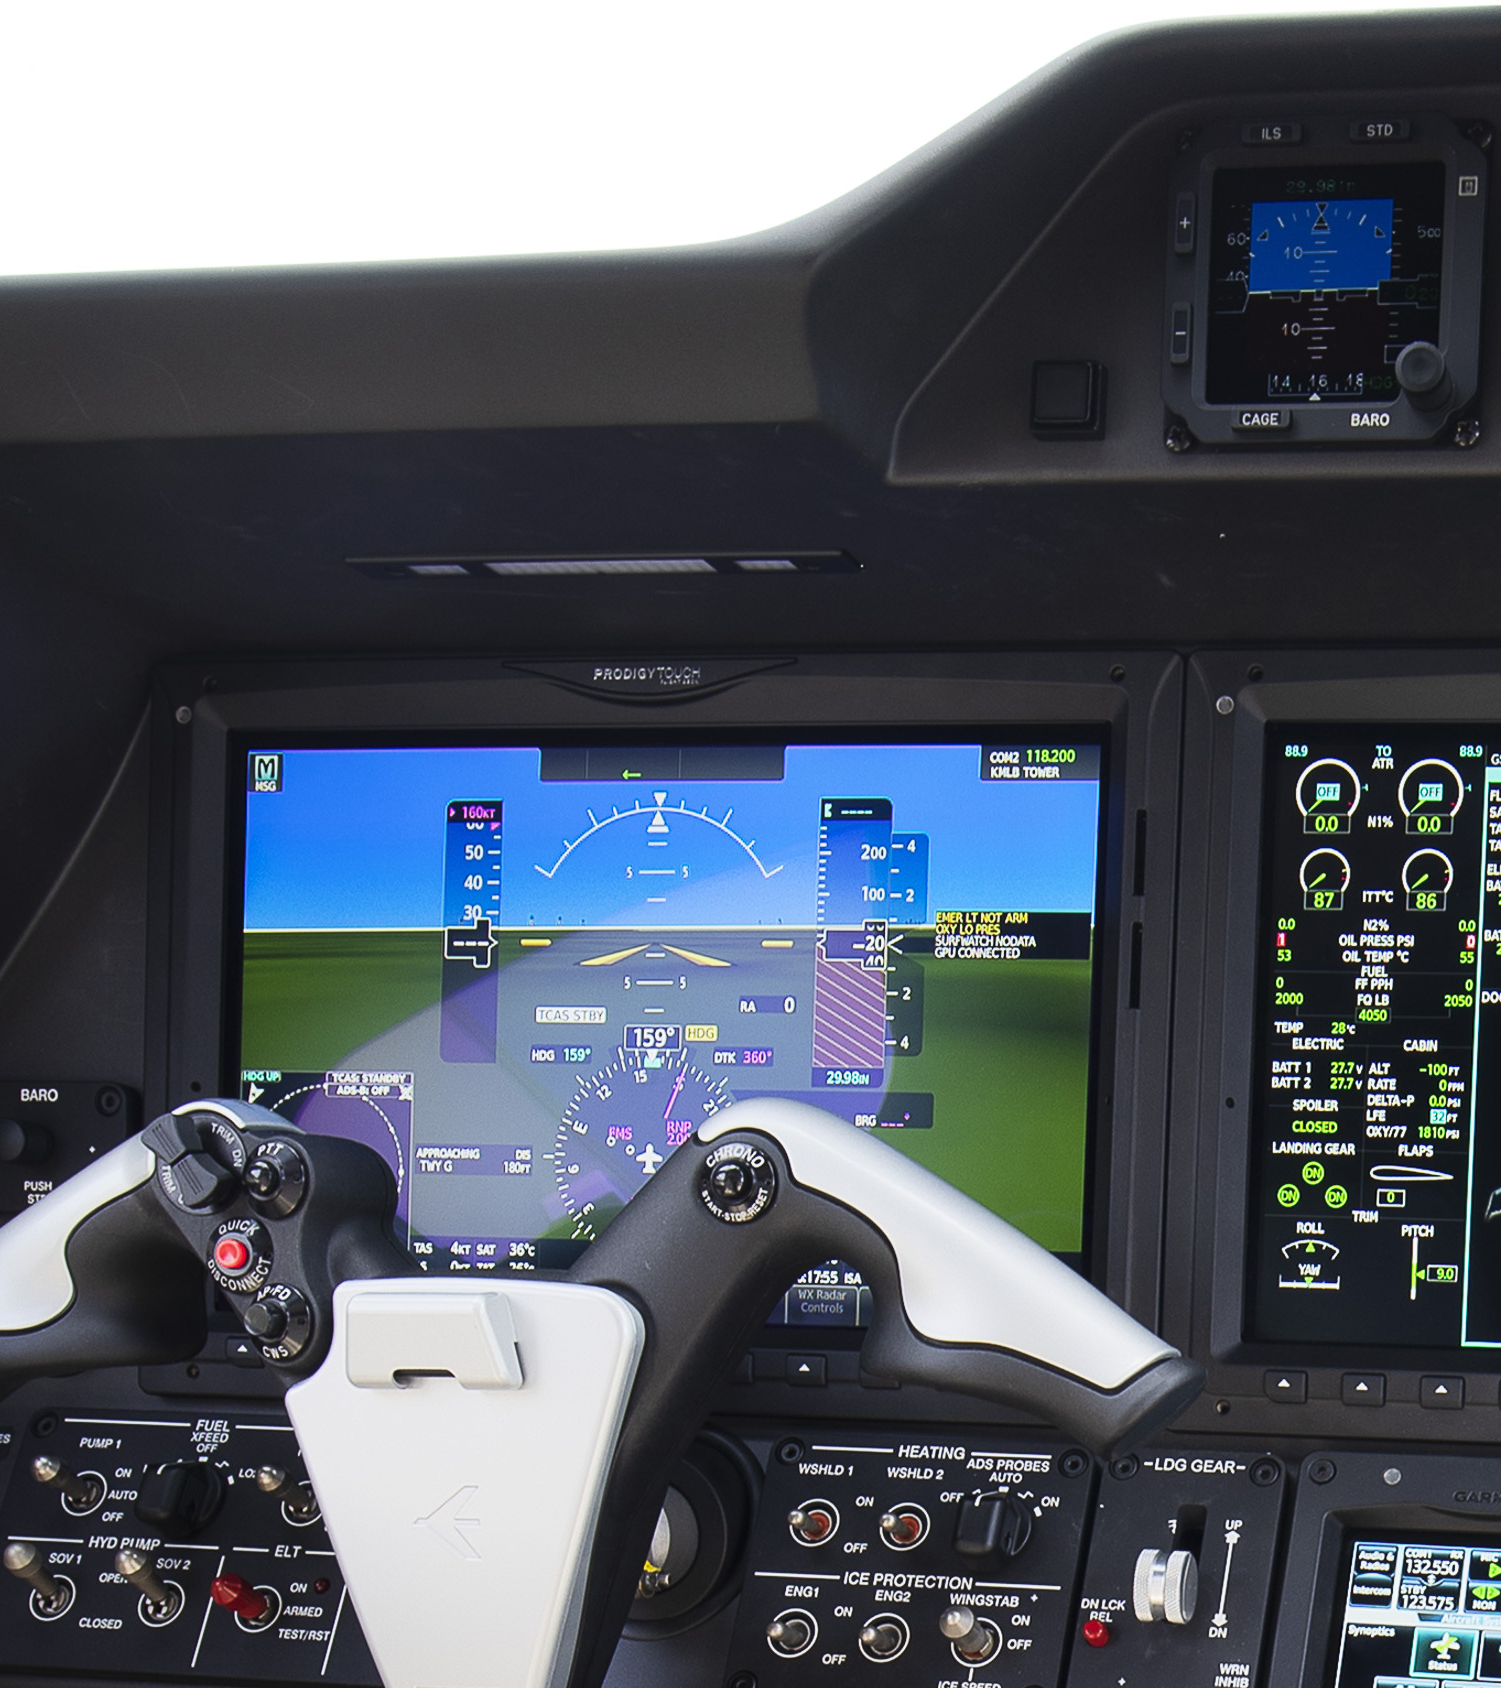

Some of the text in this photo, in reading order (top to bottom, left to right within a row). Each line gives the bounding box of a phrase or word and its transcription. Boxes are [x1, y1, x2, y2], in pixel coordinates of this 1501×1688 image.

[1261, 127, 1282, 140] ILS
[1367, 124, 1393, 137] STD
[1242, 412, 1389, 426] CAGE BARO
[861, 845, 887, 860] 200
[861, 886, 885, 901] 100
[1339, 935, 1414, 947] OIL PRESS PSI
[1358, 1009, 1387, 1021] 4050
[688, 1027, 715, 1039] HDG
[1293, 1038, 1344, 1050] ELECTRIC
[1404, 1040, 1438, 1052] CABIN
[20, 1088, 59, 1102] BARO
[1293, 1100, 1338, 1112] SPOILER
[1292, 1121, 1338, 1133] CLOSED
[416, 1148, 480, 1160] APPROACHING
[1272, 1142, 1355, 1155] LANDING GEAR
[1398, 1145, 1433, 1157] FLAPS
[705, 1144, 765, 1168] CHRONO
[1352, 1211, 1378, 1222] TRIM
[1402, 1225, 1434, 1237] PITCH
[798, 1289, 846, 1301] WX Radar
[801, 1301, 843, 1313] Controls
[196, 1419, 231, 1432] FUEL
[190, 1432, 228, 1443] XFEED
[898, 1445, 965, 1460] HEATING
[966, 1459, 1049, 1473] ADS PROBES
[1154, 1458, 1236, 1474] LDG GEAR
[108, 1490, 137, 1501] AUTO
[274, 1545, 301, 1558] ELT
[1405, 1559, 1459, 1576] 132.550
[843, 1571, 973, 1591] ICE PROTECTION
[950, 1593, 1019, 1608] WINGSTAB
[283, 1606, 323, 1617] ARMED
[79, 1618, 122, 1630] CLOSED
[278, 1629, 330, 1641] TEST/RST
[1220, 1663, 1250, 1675] WRN
[1215, 1675, 1250, 1688] INHIB
